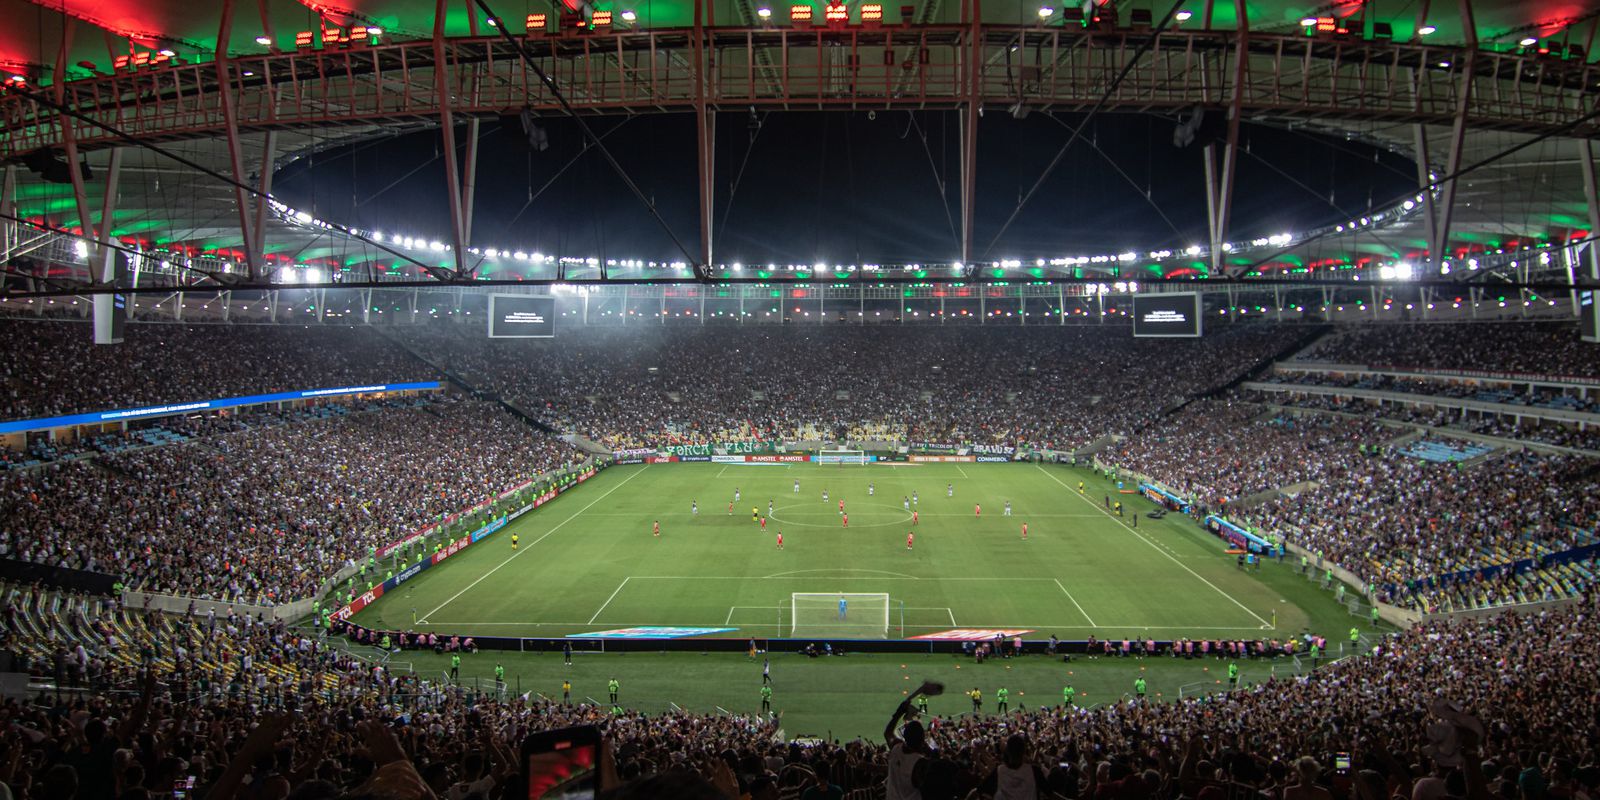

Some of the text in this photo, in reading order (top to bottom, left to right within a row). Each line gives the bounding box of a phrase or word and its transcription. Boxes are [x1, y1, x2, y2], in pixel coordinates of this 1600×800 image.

[400, 565, 421, 580] crypto.com
[362, 590, 376, 605] TCL
[338, 605, 353, 620] TCL
